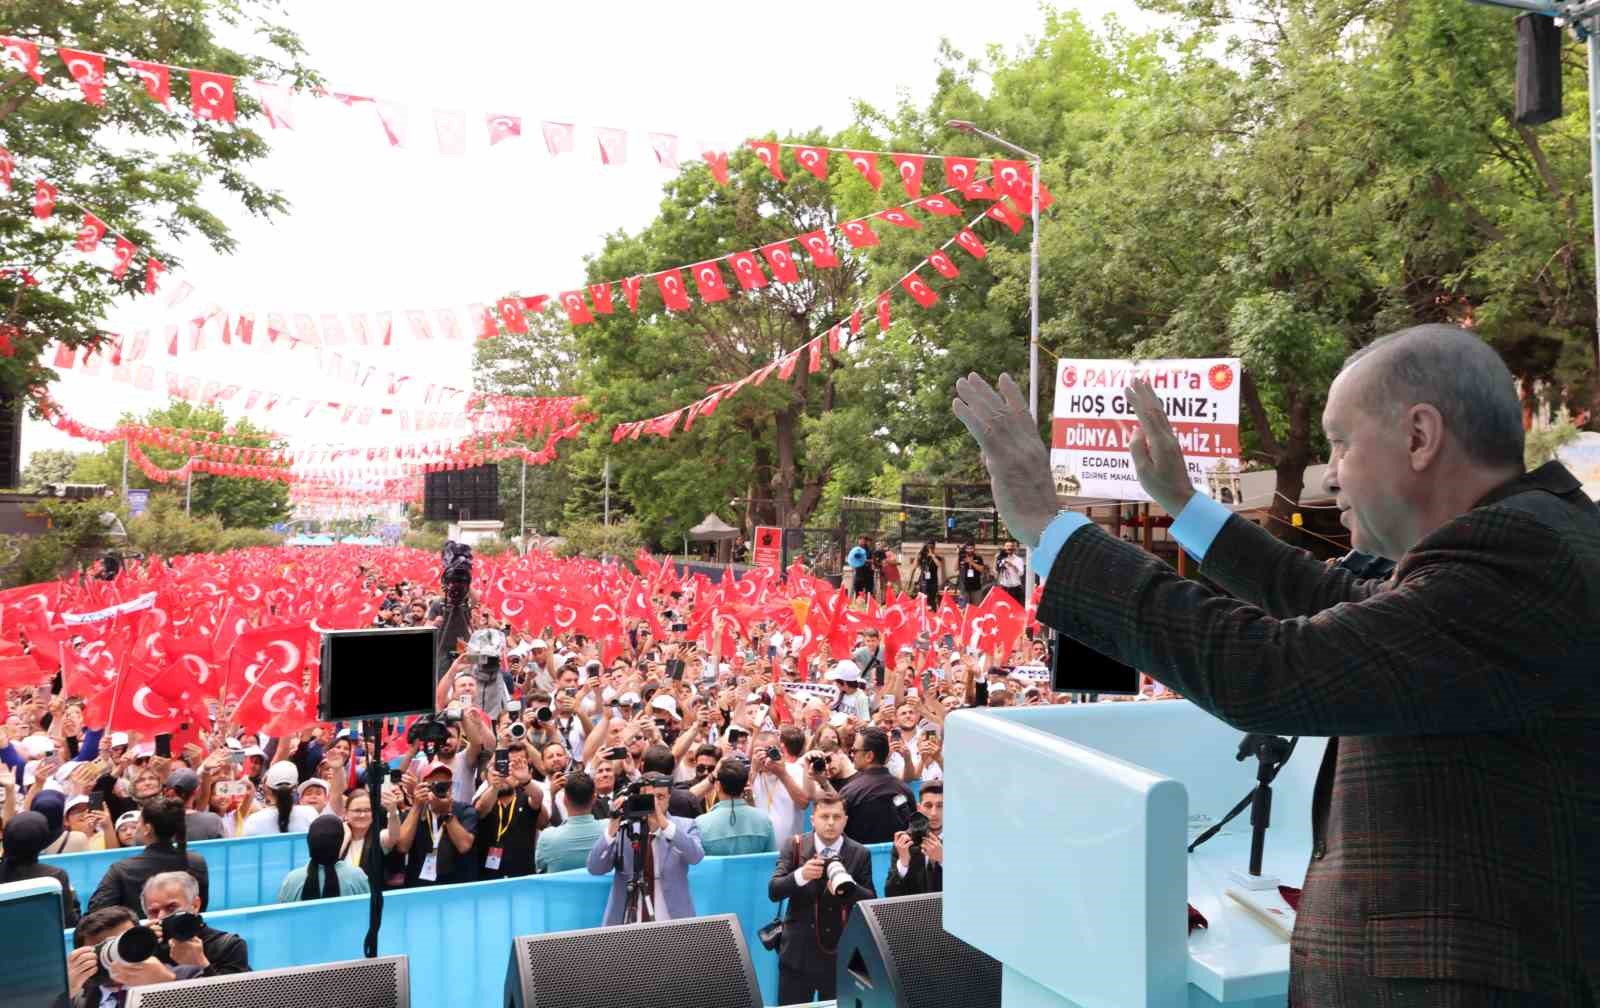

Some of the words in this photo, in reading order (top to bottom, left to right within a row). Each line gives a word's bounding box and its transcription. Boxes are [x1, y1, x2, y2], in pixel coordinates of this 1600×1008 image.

[1071, 394, 1105, 416] HOŞ
[1066, 423, 1118, 448] DÜNYA
[1110, 473, 1137, 482] MAHAL
